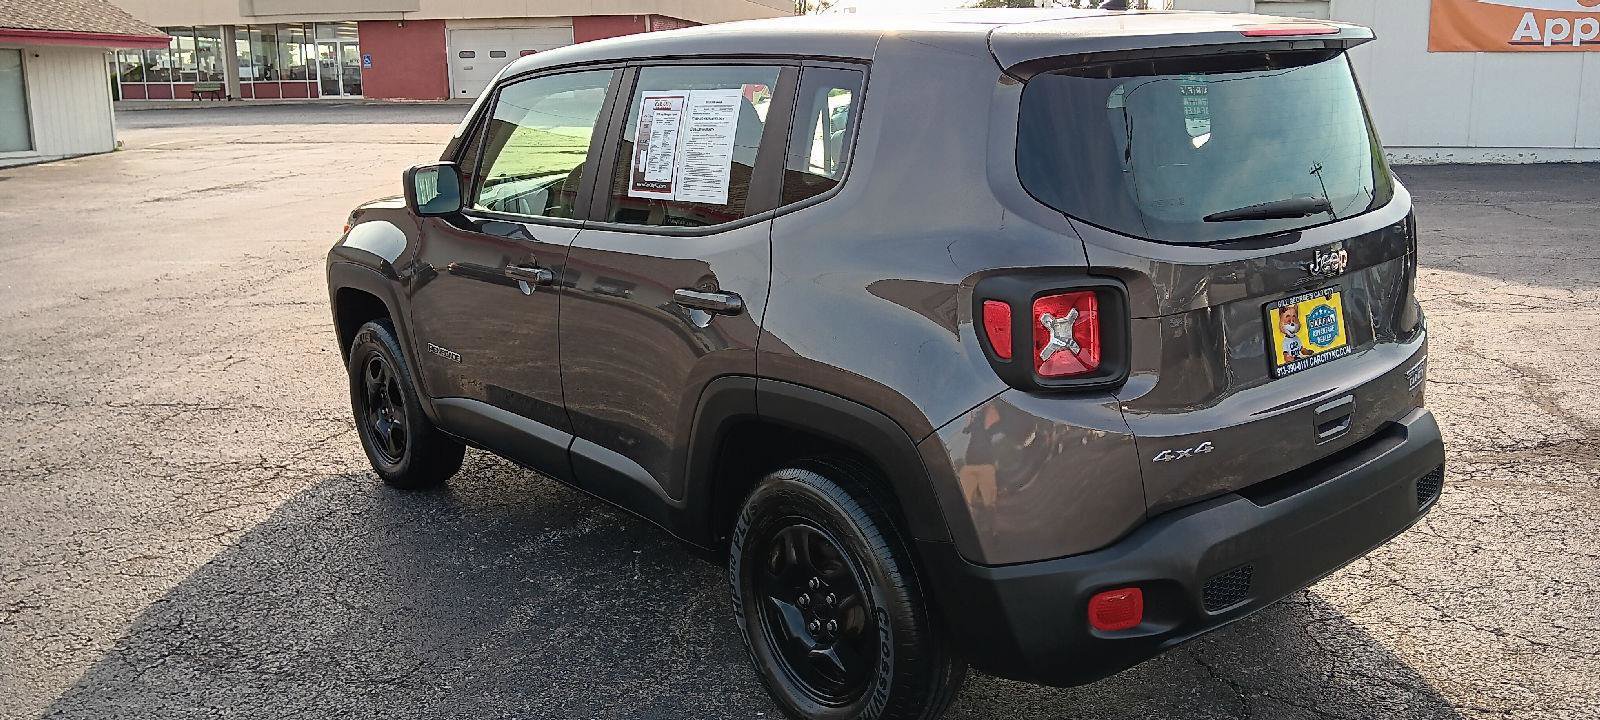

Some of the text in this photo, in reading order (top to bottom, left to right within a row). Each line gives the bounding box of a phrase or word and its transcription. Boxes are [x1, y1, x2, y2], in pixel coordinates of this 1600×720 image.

[1511, 11, 1600, 47] App
[1309, 248, 1349, 276] Jeep
[1152, 440, 1215, 463] 4x4
